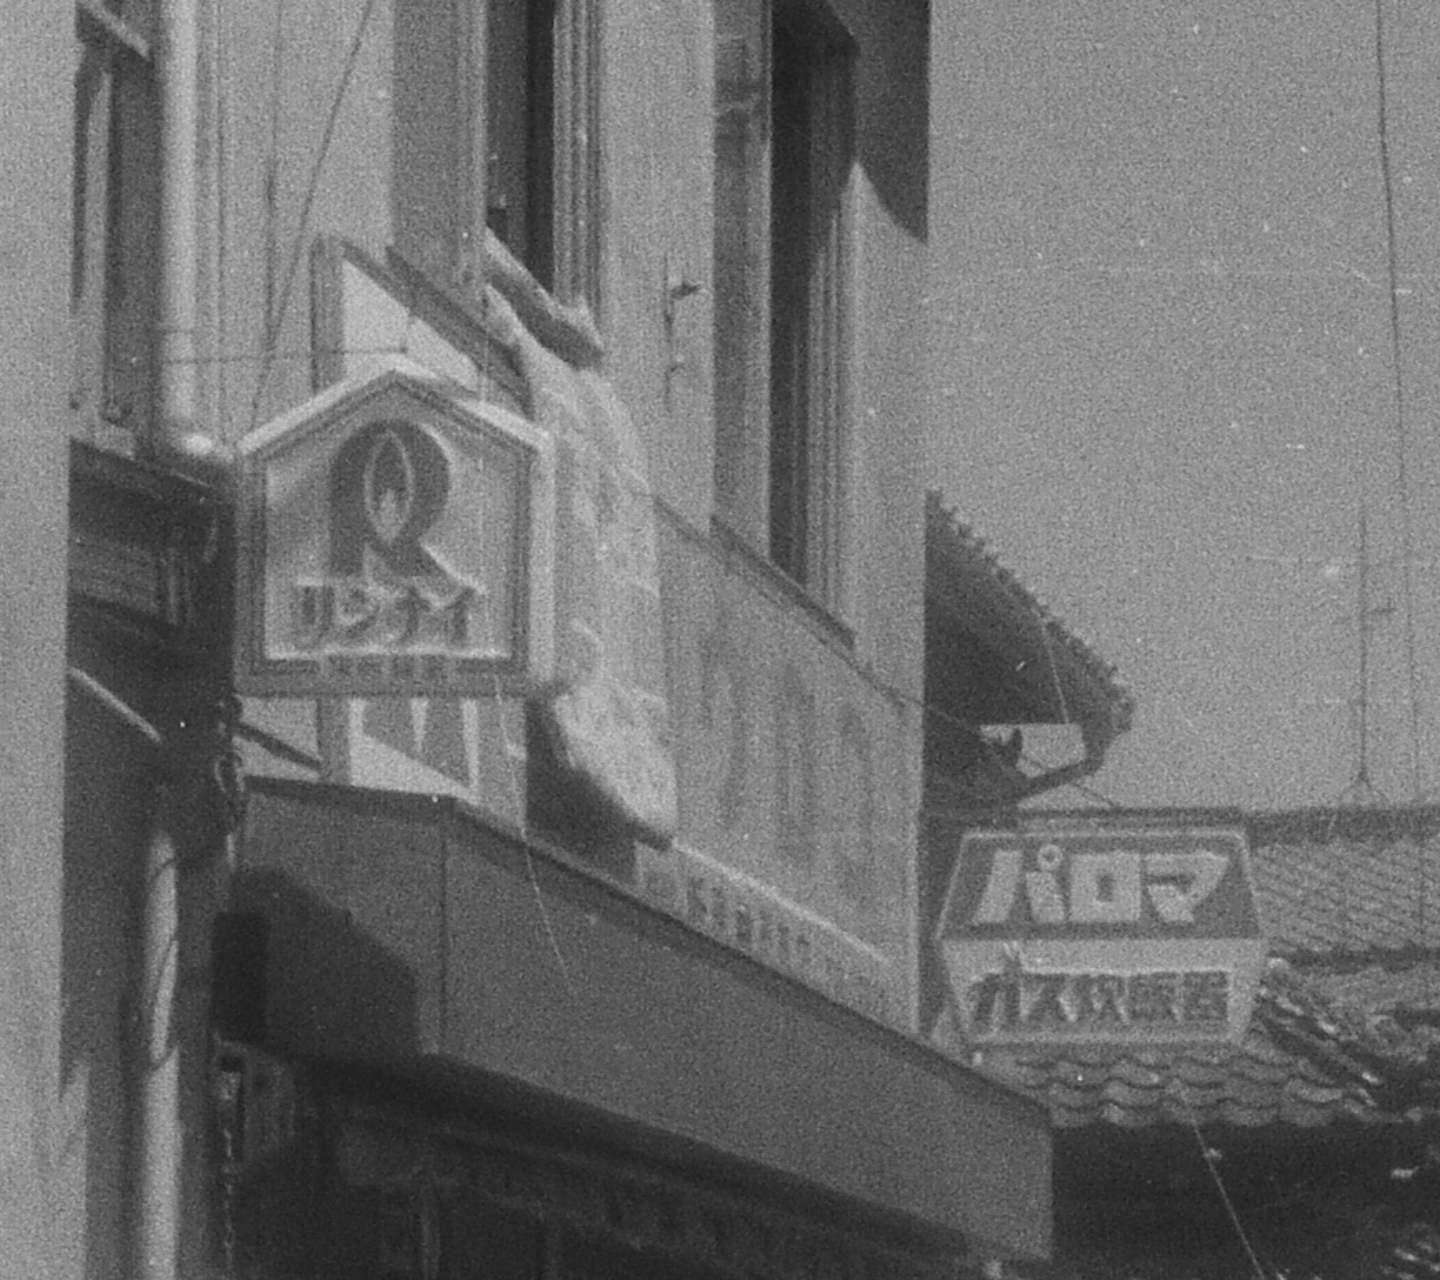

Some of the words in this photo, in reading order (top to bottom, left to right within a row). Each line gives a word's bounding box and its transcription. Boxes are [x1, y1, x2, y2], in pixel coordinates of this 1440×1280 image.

[294, 584, 481, 650] リンナイ
[971, 844, 1232, 925] パロマ
[967, 964, 1230, 1033] ガス炊飯器
